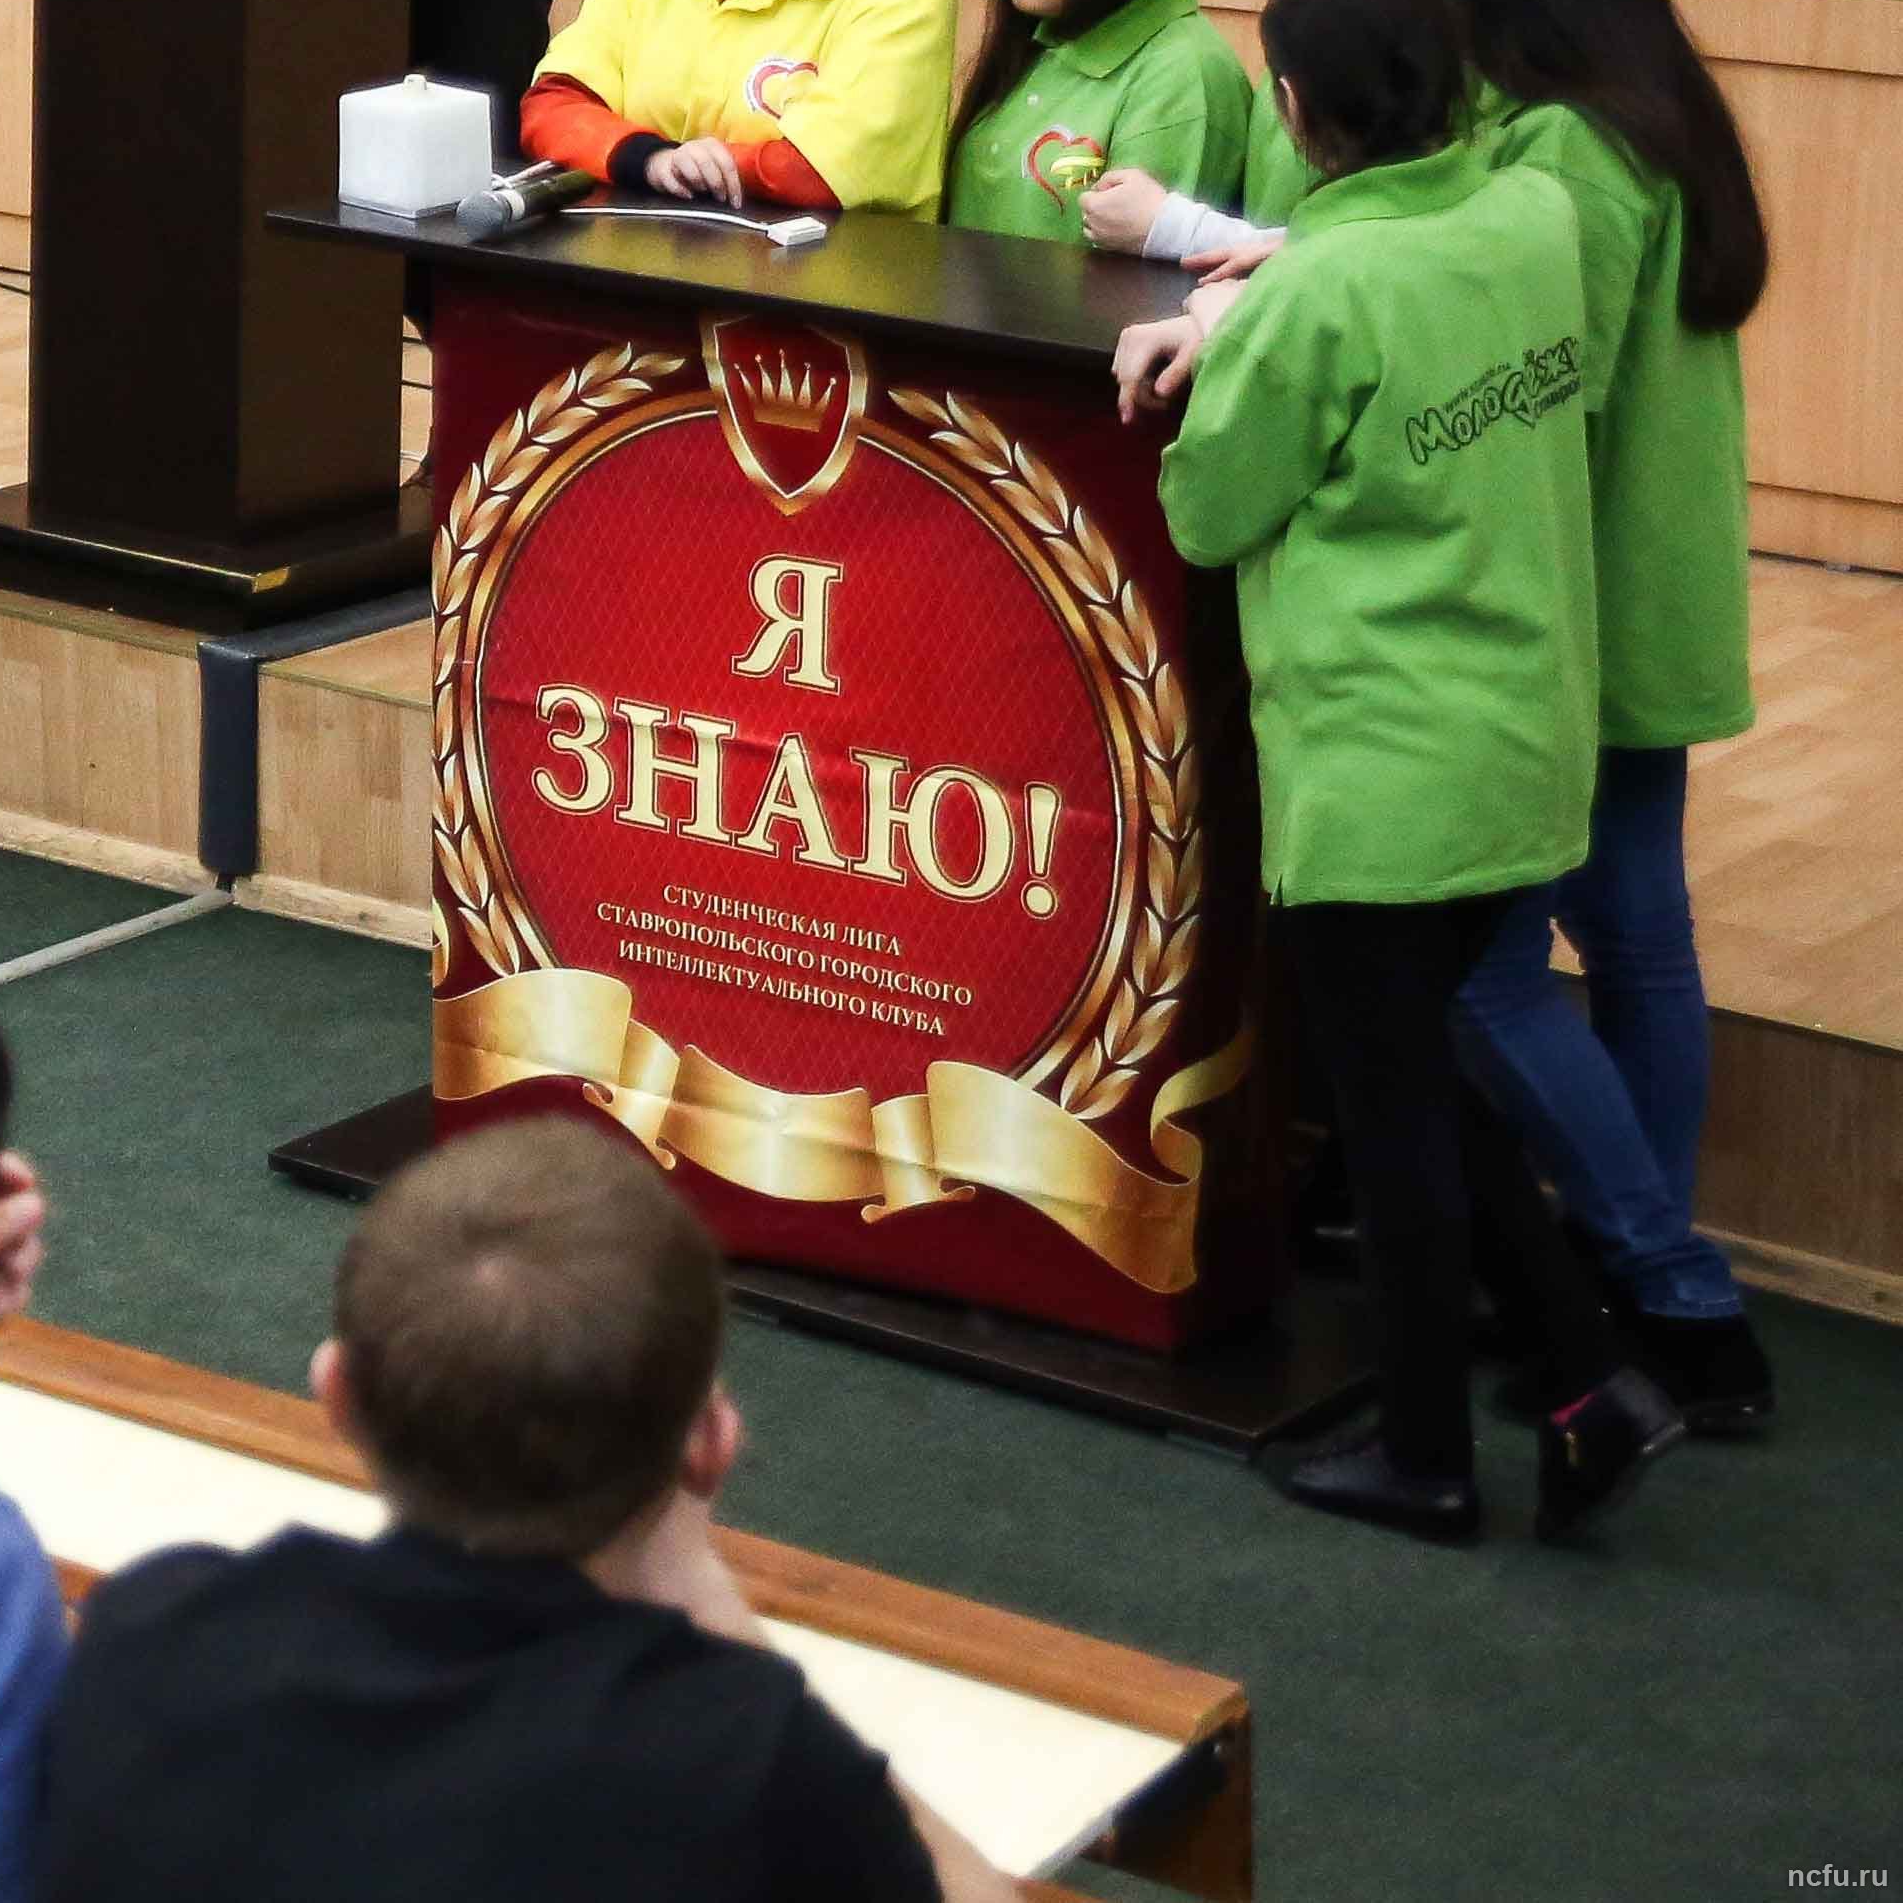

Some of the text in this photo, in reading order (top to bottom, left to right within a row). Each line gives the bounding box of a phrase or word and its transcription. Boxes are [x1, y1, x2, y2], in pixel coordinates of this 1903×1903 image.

[732, 552, 844, 695] Я
[531, 683, 1063, 920] ЗНАЮ!
[597, 902, 973, 1006] СТАВРОПОЛЬСКОГО ГОРОДСКОГО
[663, 884, 902, 957] СТУДЕНЧЕСКАЯ ЛИГА
[618, 939, 945, 1036] ИНТЕЛЛЕКТУАЛЬНОГО КЛУБА
